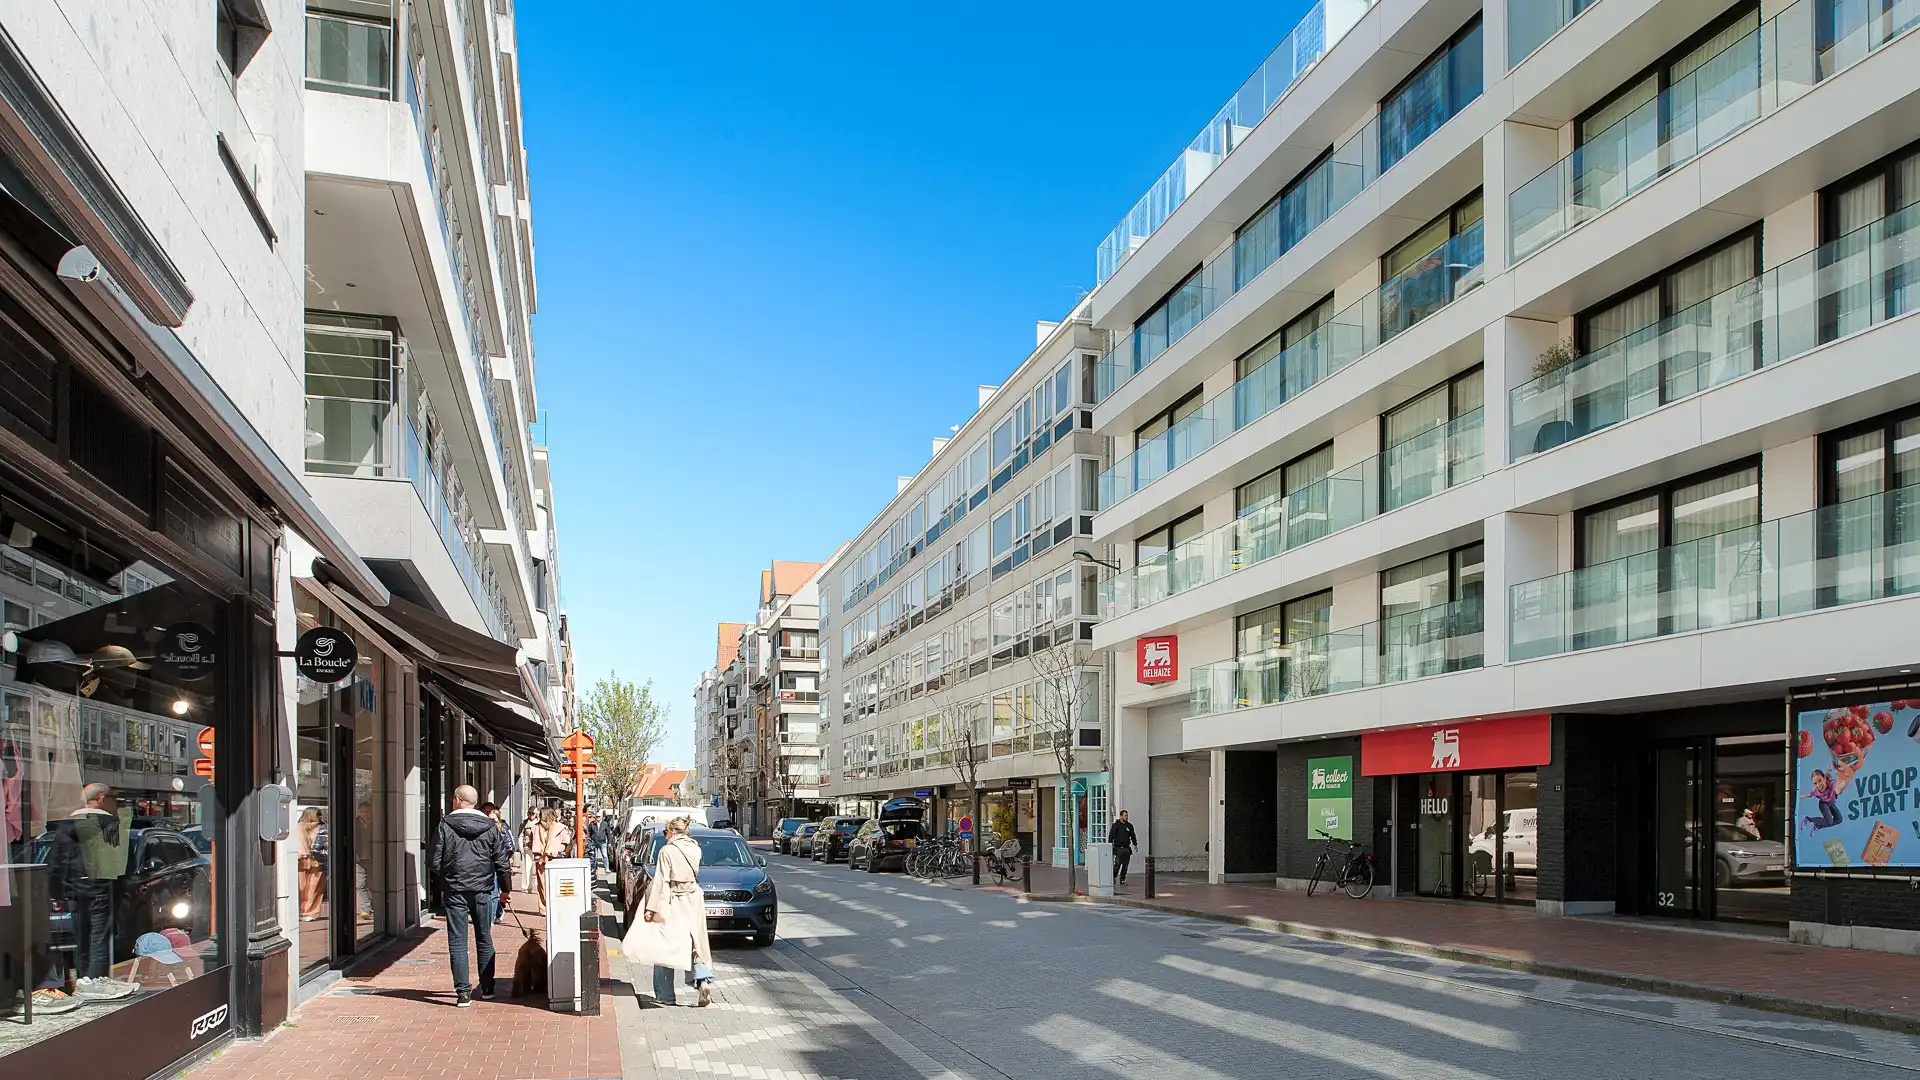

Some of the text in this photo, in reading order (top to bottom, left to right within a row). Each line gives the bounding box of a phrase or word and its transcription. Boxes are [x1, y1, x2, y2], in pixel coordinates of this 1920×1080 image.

[300, 657, 312, 666] La
[1143, 668, 1171, 678] DELHAIZE
[1326, 769, 1348, 783] collect
[1855, 767, 1917, 798] VOLOP
[1421, 798, 1448, 814] HELLO
[1848, 789, 1908, 820] START
[1659, 892, 1675, 906] 32
[192, 1005, 227, 1037] RRD
